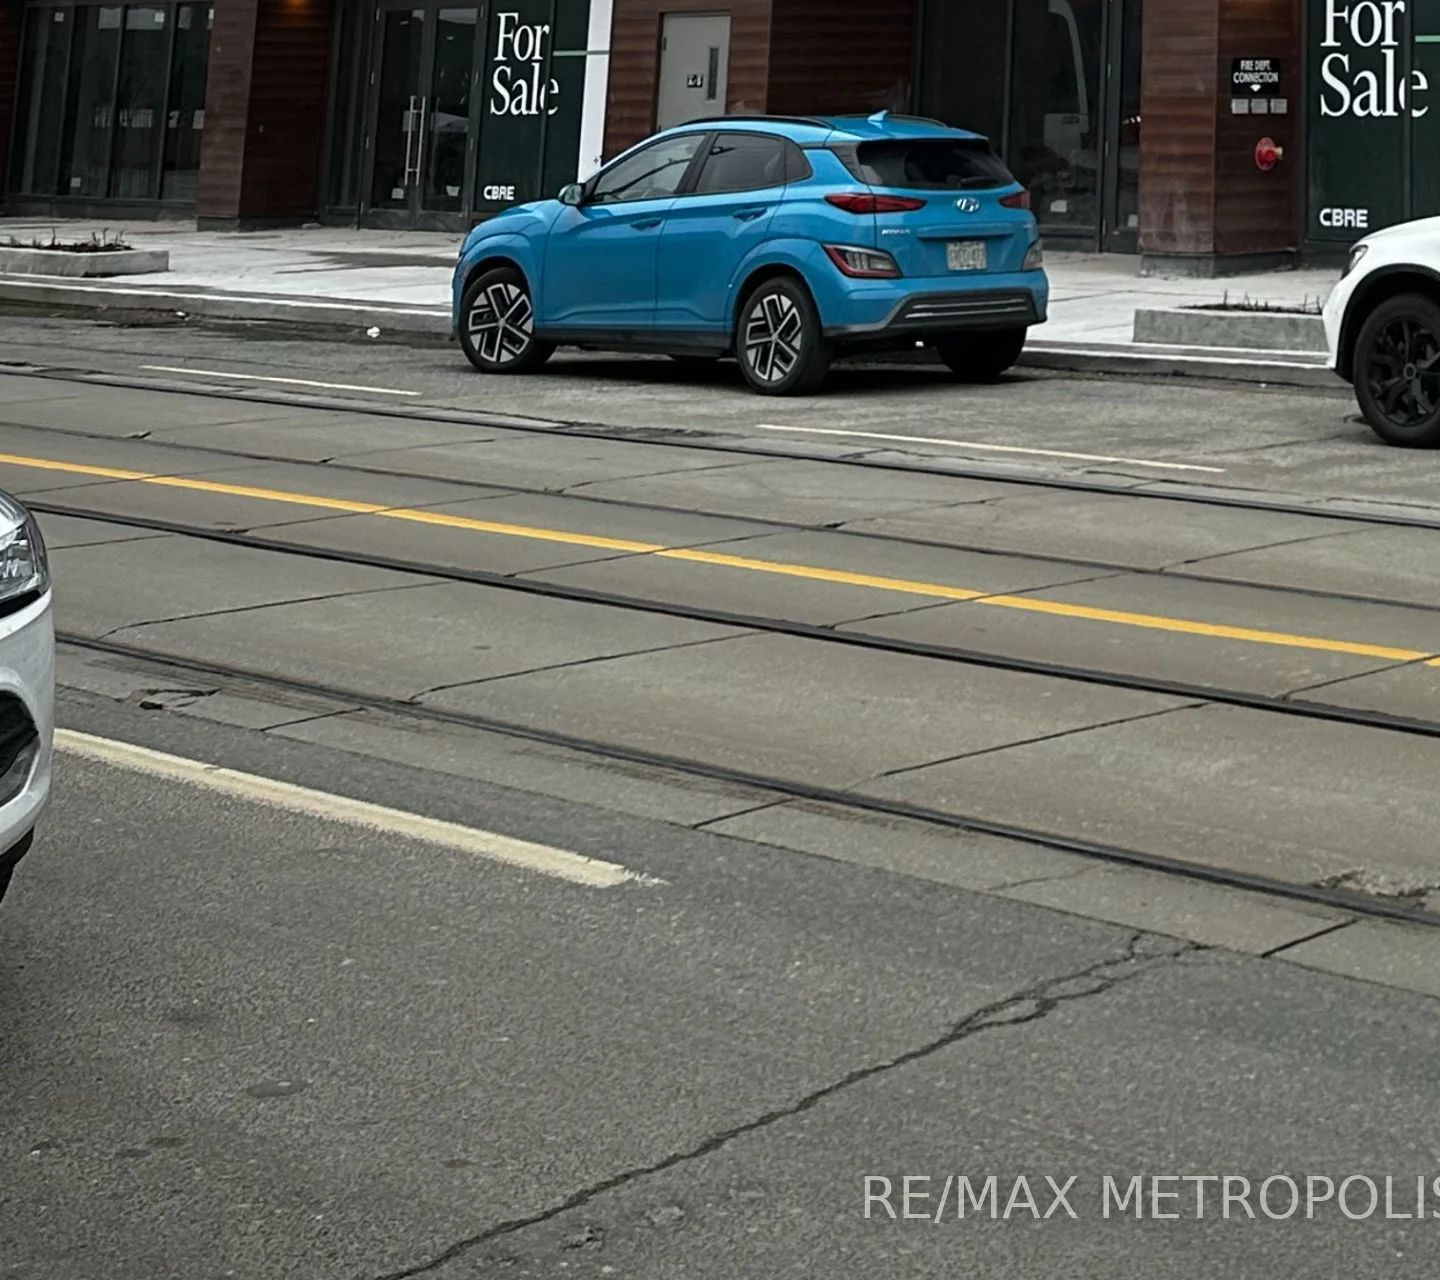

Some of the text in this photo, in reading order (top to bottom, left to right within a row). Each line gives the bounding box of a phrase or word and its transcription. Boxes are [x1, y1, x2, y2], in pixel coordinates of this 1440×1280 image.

[493, 11, 551, 62] For
[1240, 59, 1254, 71] FIRE
[1233, 71, 1279, 84] CONNECTION
[1319, 48, 1429, 118] Sale
[489, 61, 560, 116] Sale
[483, 185, 516, 201] CBRE
[1318, 207, 1369, 228] CBRE
